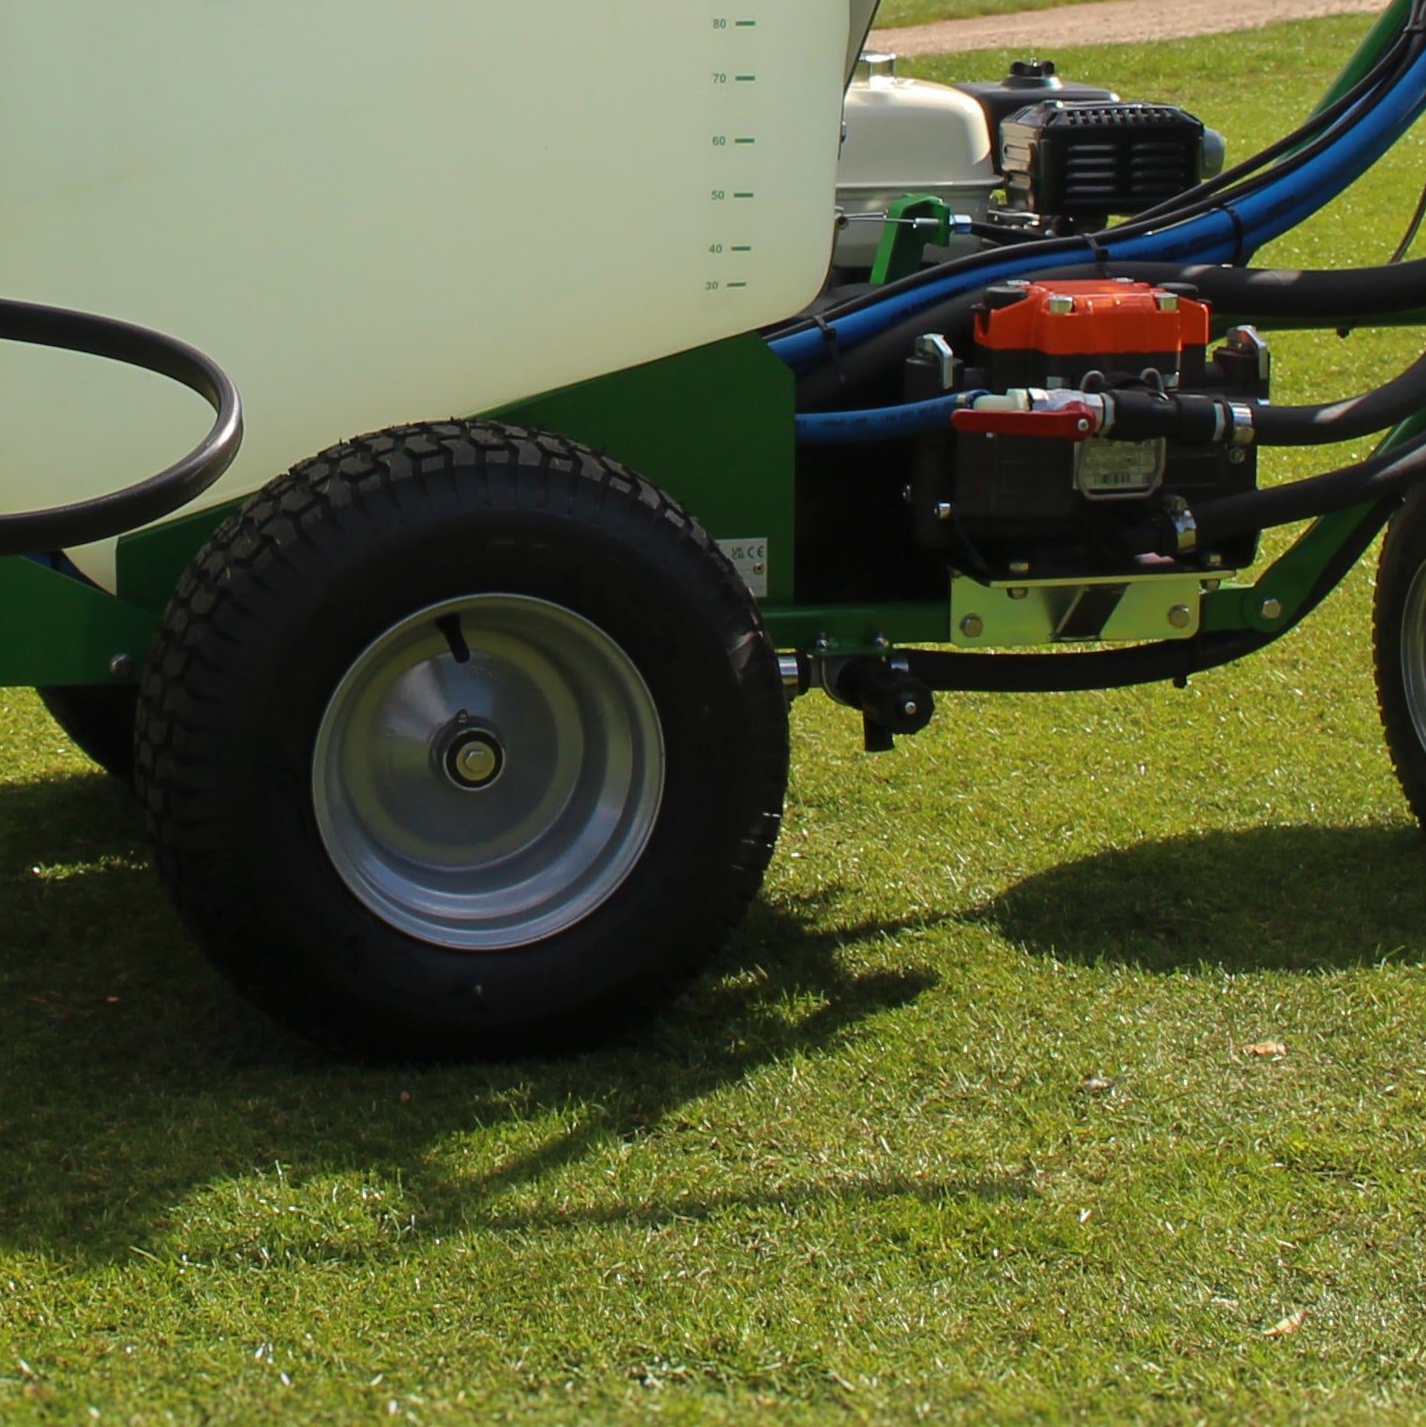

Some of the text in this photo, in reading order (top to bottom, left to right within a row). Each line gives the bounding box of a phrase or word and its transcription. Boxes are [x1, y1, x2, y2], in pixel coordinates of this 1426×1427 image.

[712, 17, 727, 30] 80
[712, 72, 727, 84] 70
[711, 135, 726, 147] 60
[711, 189, 725, 201] 50
[708, 243, 723, 255] 40
[704, 280, 719, 291] 30
